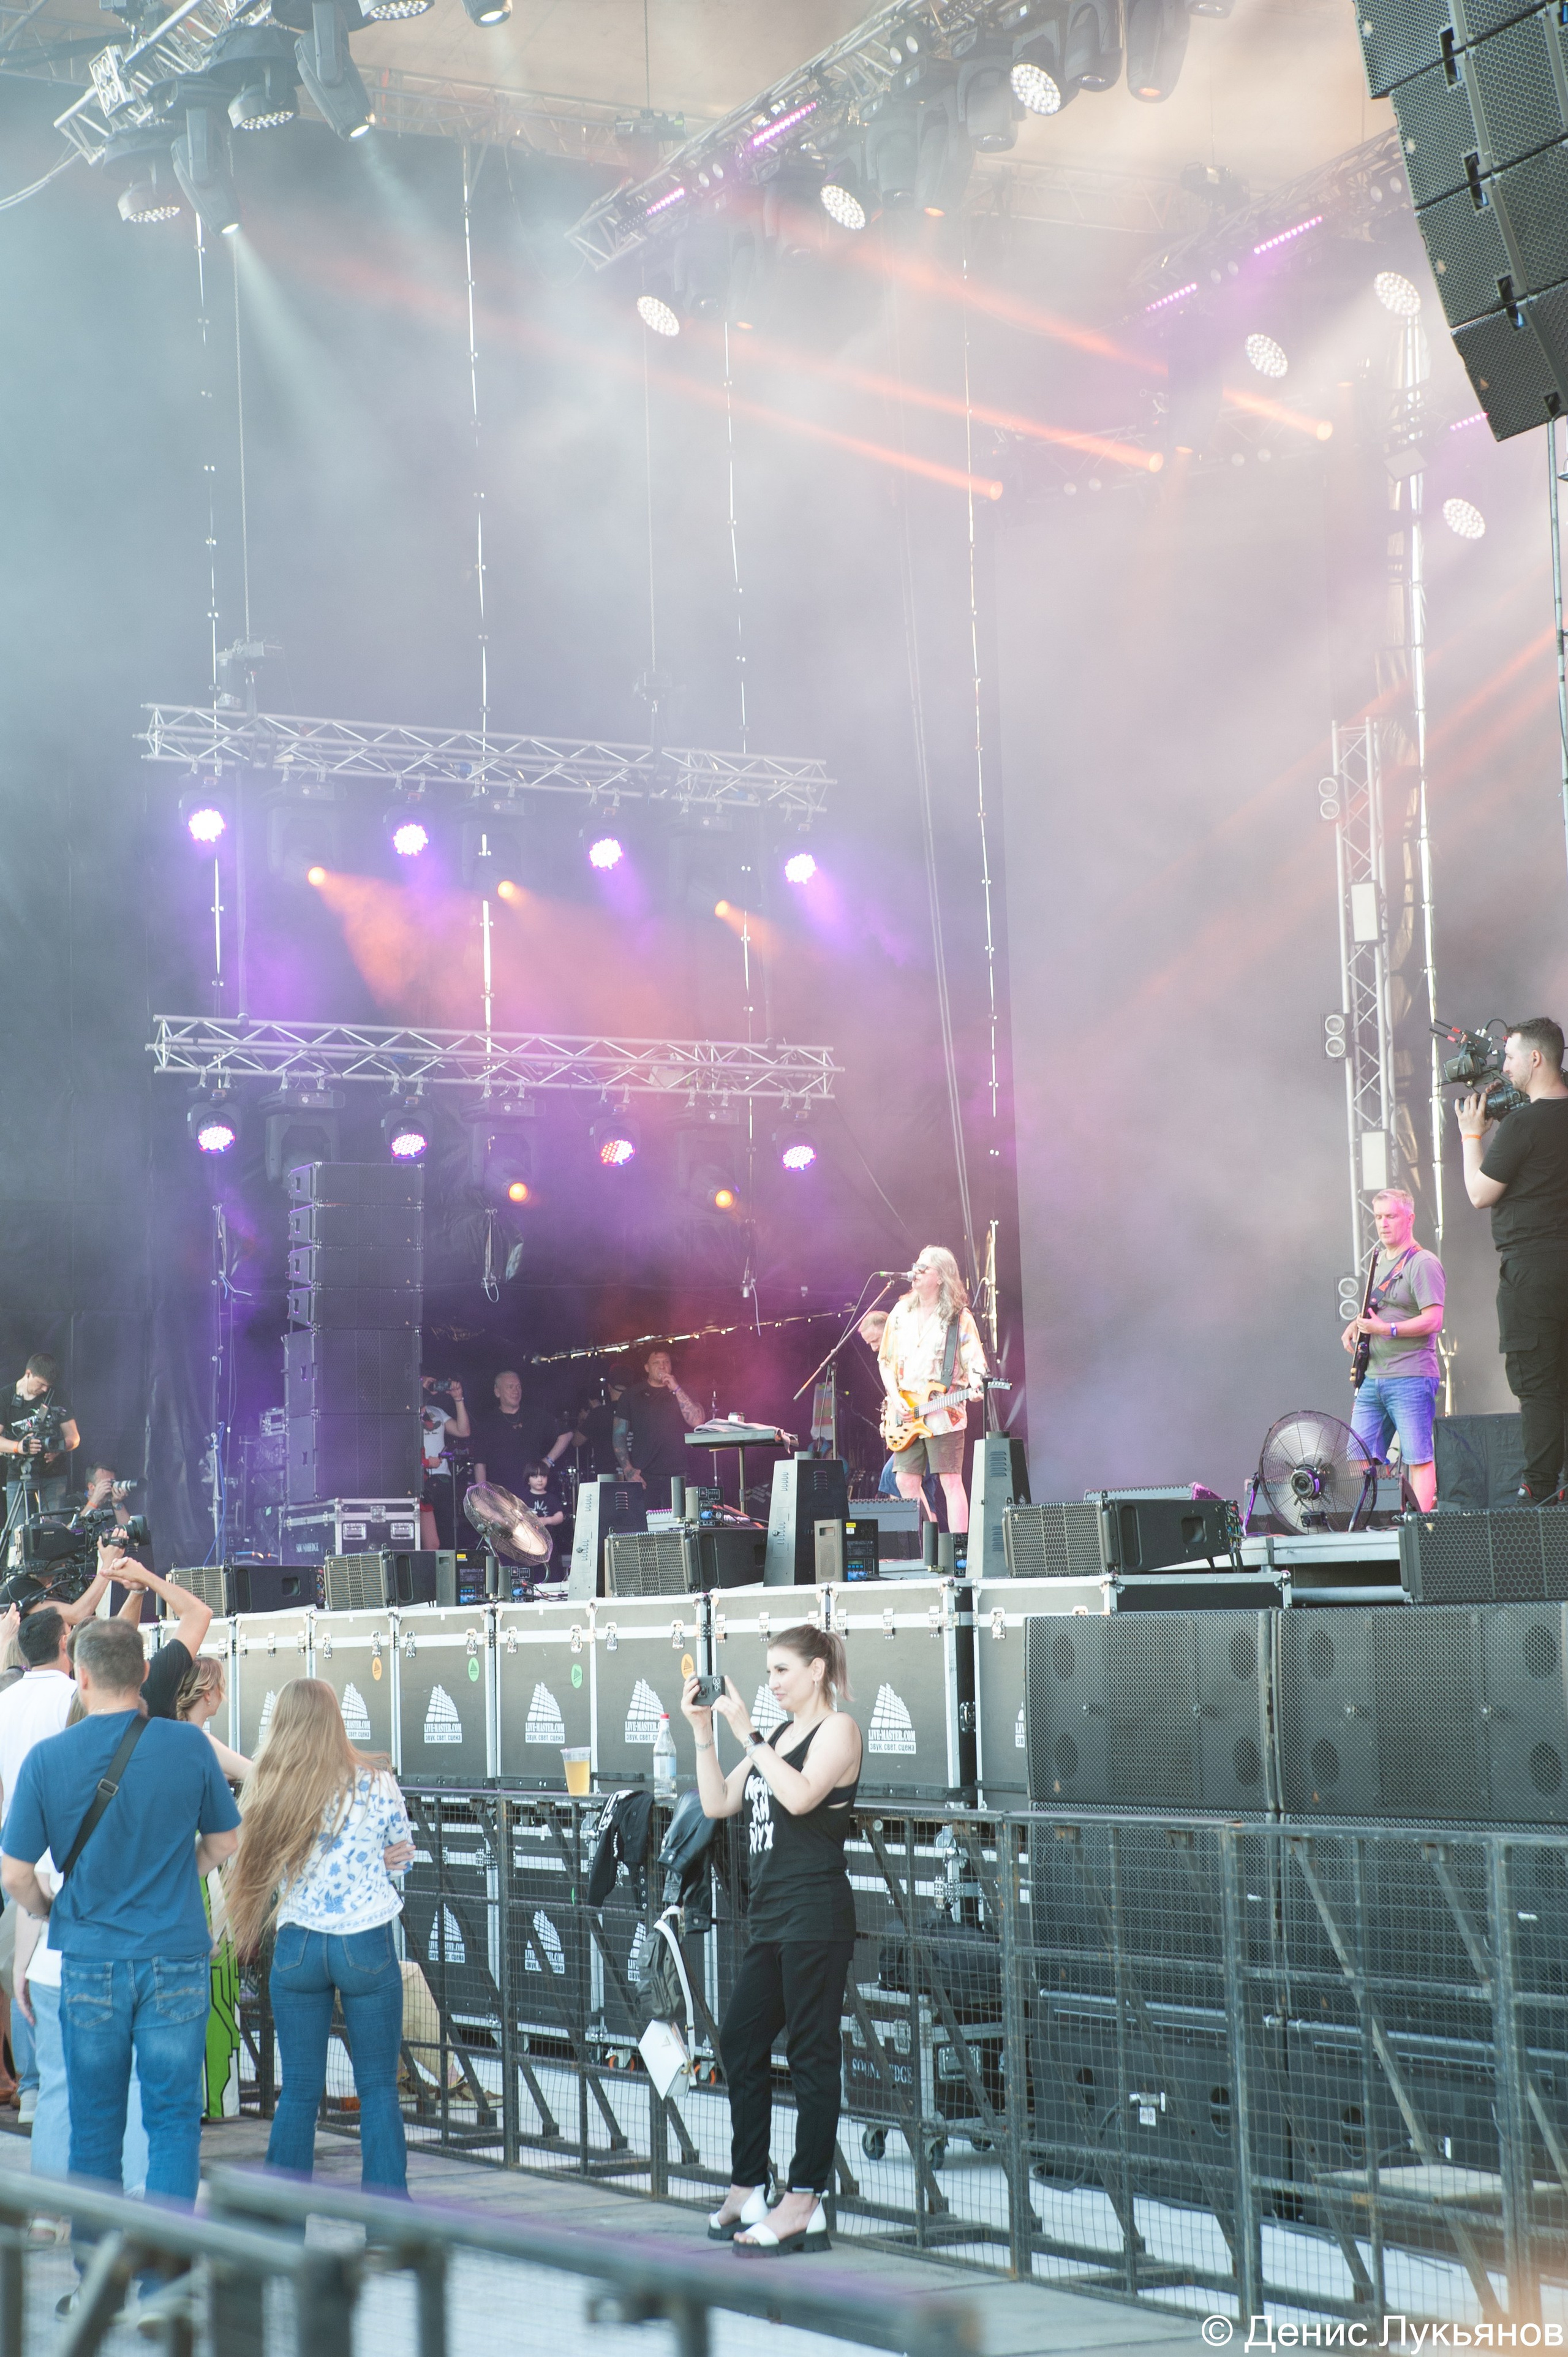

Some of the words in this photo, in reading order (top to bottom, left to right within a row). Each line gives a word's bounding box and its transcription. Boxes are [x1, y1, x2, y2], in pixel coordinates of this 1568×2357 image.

[345, 1720, 371, 1730] -MASTER.COM
[424, 1723, 462, 1733] LIVE-MASTER.COM
[526, 1722, 565, 1733] LIVE-MASTER.COM
[868, 1729, 916, 1741] LIVE-MASTER.COM
[899, 1744, 914, 1752] сцена
